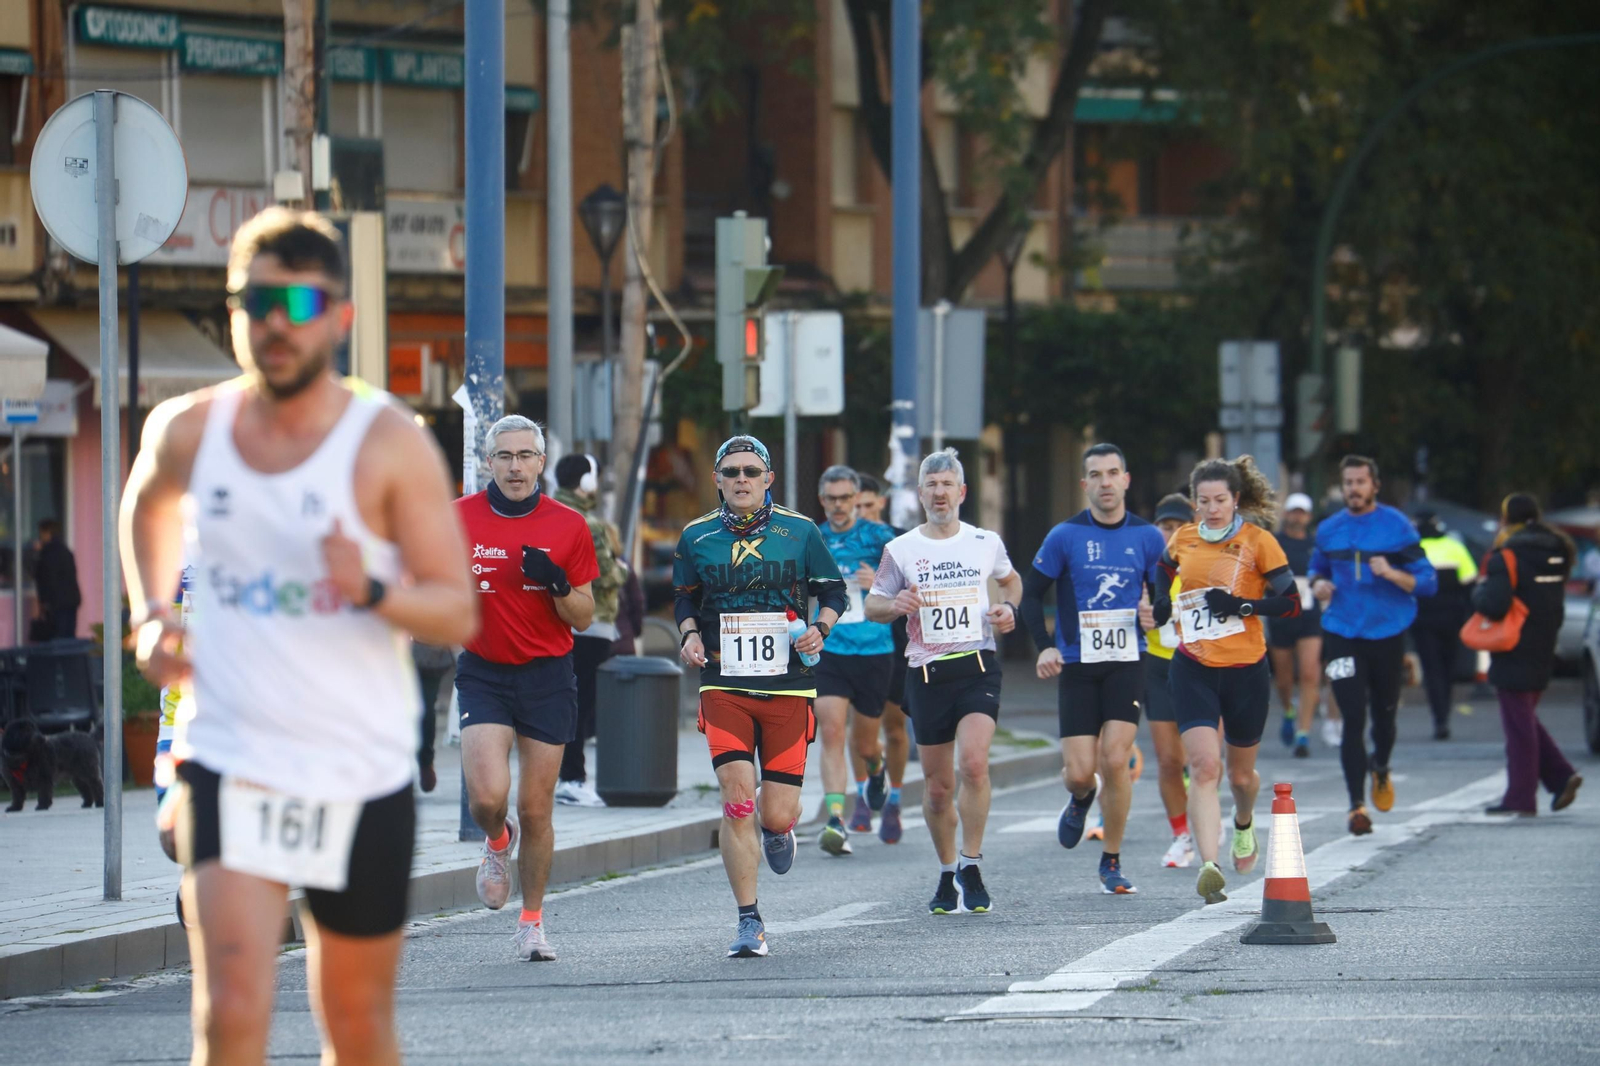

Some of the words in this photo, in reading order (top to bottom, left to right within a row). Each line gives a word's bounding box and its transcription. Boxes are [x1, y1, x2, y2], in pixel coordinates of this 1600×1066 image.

[770, 525, 790, 537] SIG
[480, 547, 506, 556] califas
[731, 535, 767, 570] IX
[918, 572, 930, 583] 37
[933, 567, 981, 581] MARATÓN
[932, 561, 963, 572] MEDIA
[722, 616, 741, 634] XLI
[932, 606, 970, 631] 204
[733, 635, 775, 661] 118
[1092, 628, 1126, 650] 840
